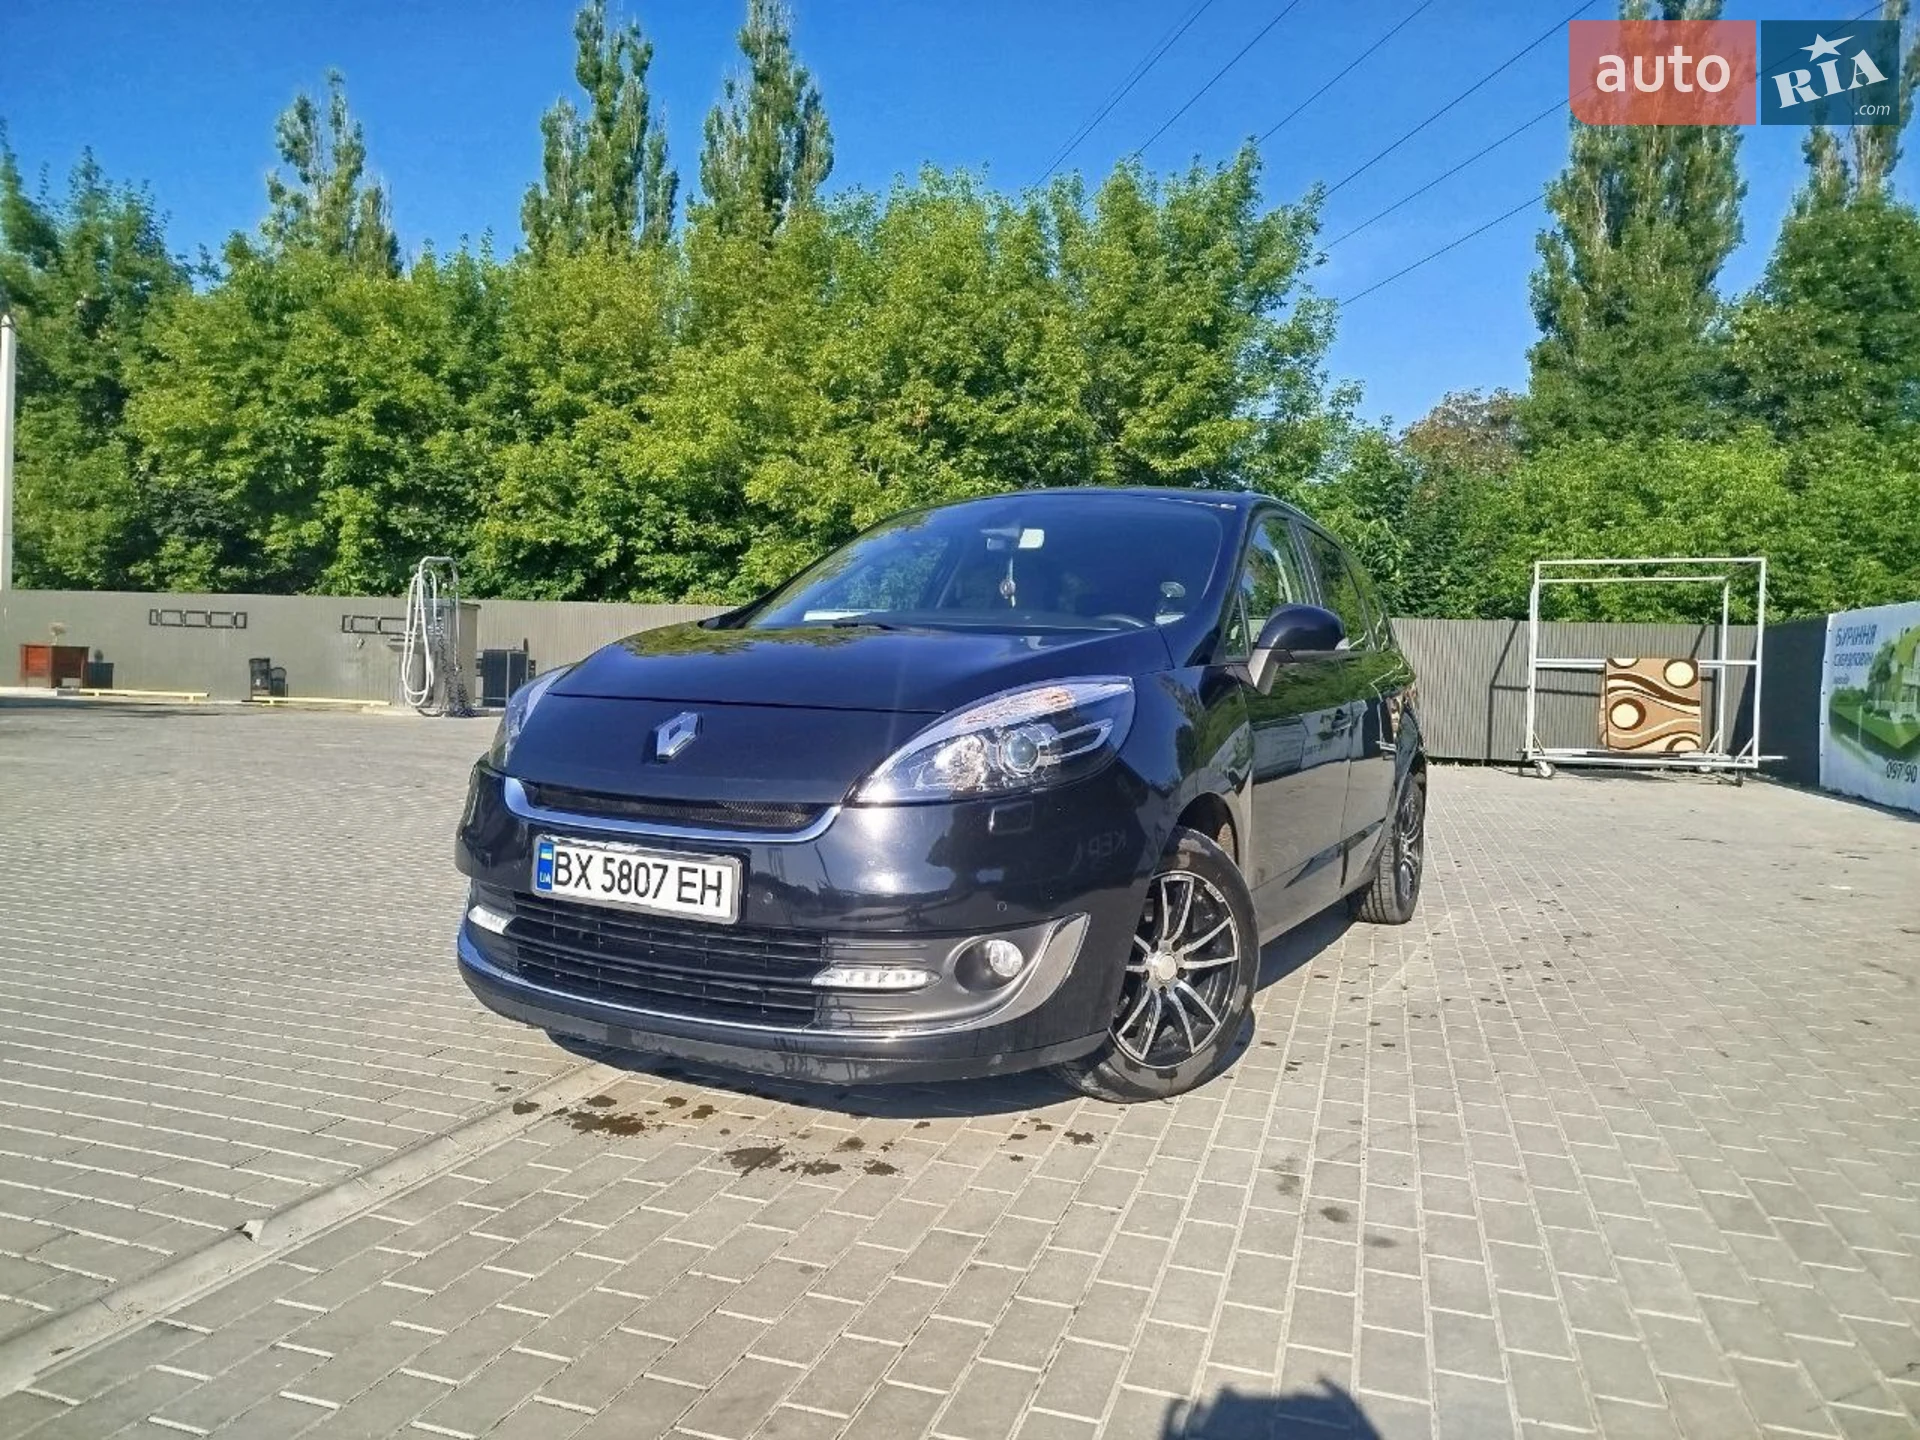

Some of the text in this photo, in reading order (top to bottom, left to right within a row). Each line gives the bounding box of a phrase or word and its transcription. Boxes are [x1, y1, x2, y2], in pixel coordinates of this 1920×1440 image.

[554, 851, 723, 907] BX 5807 EH
